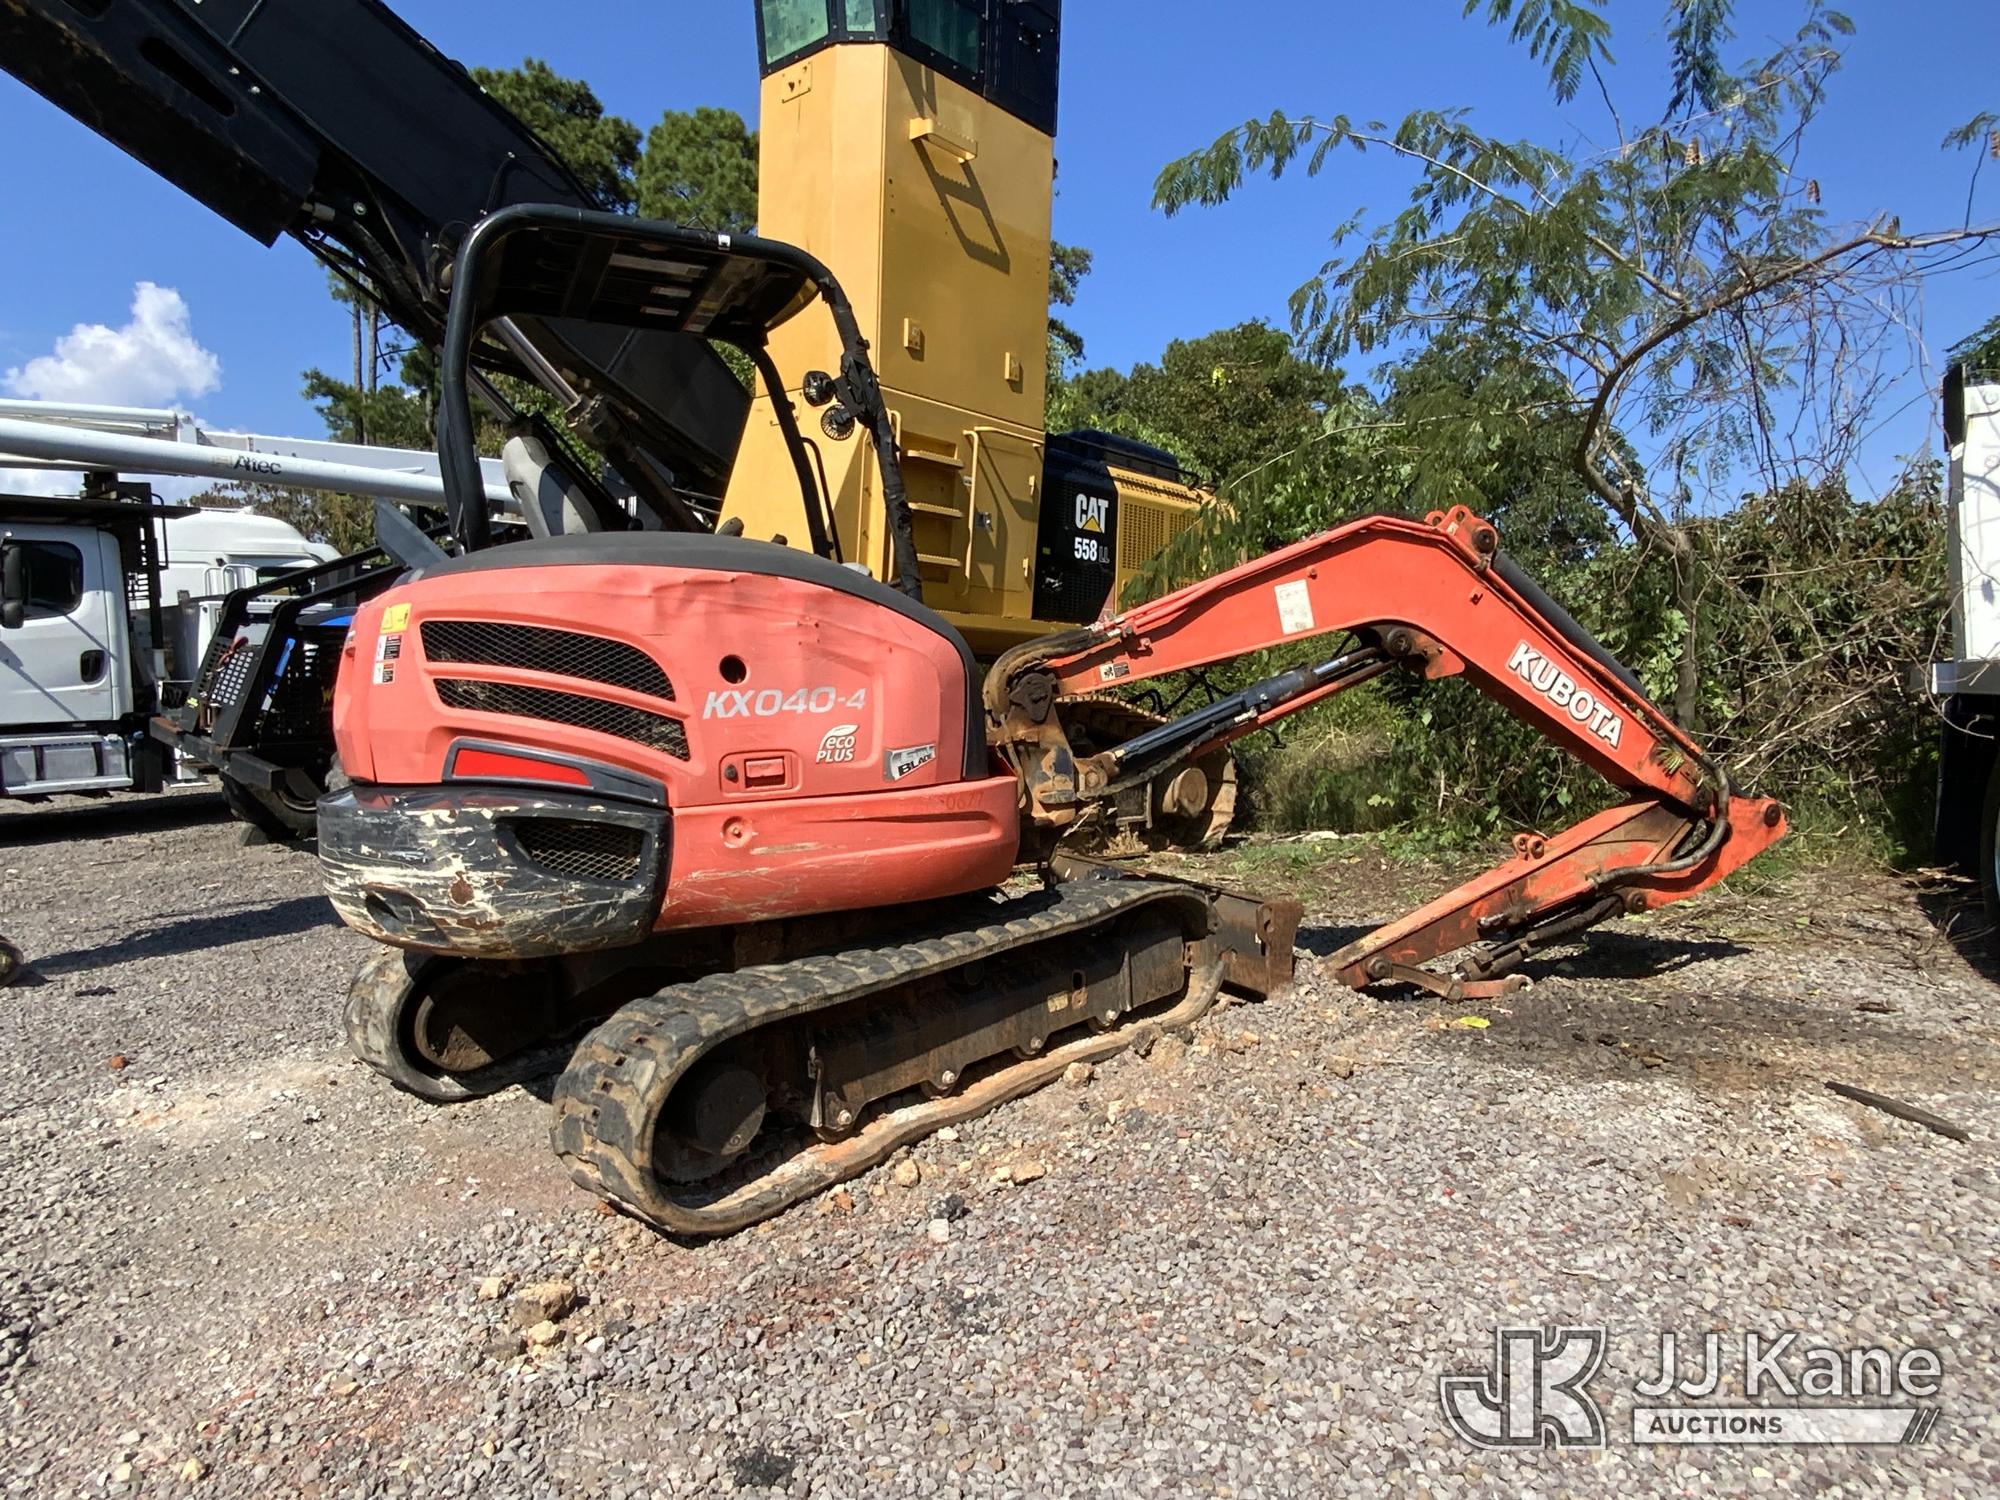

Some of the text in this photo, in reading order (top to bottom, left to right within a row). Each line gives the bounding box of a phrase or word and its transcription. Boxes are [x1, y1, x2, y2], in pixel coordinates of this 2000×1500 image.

[233, 455, 282, 475] Altec
[1075, 493, 1109, 534] CAT
[1074, 536, 1097, 562] 558
[702, 686, 867, 720] KX040-4
[1508, 642, 1624, 750] KUBOTA
[825, 735, 856, 750] eco
[815, 749, 854, 764] PLUS
